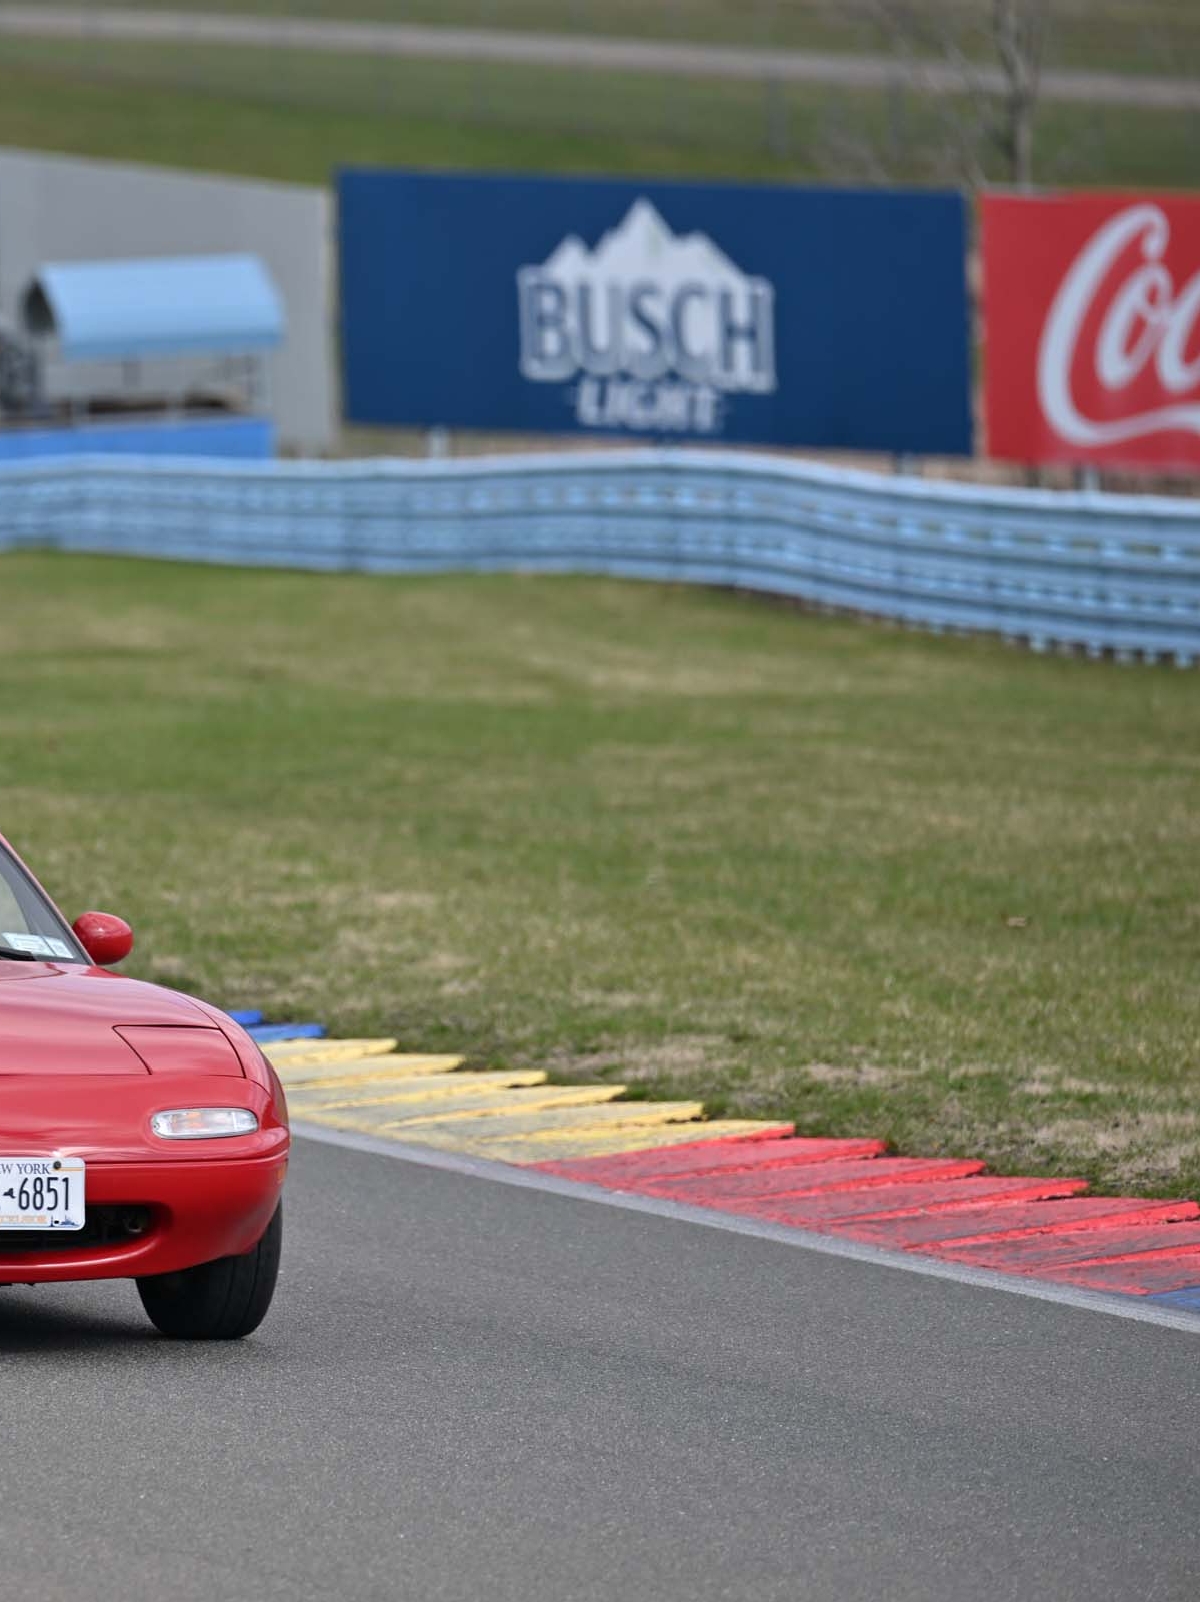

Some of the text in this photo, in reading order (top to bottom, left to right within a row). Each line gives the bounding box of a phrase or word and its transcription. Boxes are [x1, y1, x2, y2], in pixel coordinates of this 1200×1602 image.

[521, 270, 773, 388] BUSCH
[576, 377, 722, 431] LIGHT
[17, 1163, 50, 1175] YORK
[18, 1176, 69, 1211] 6851
